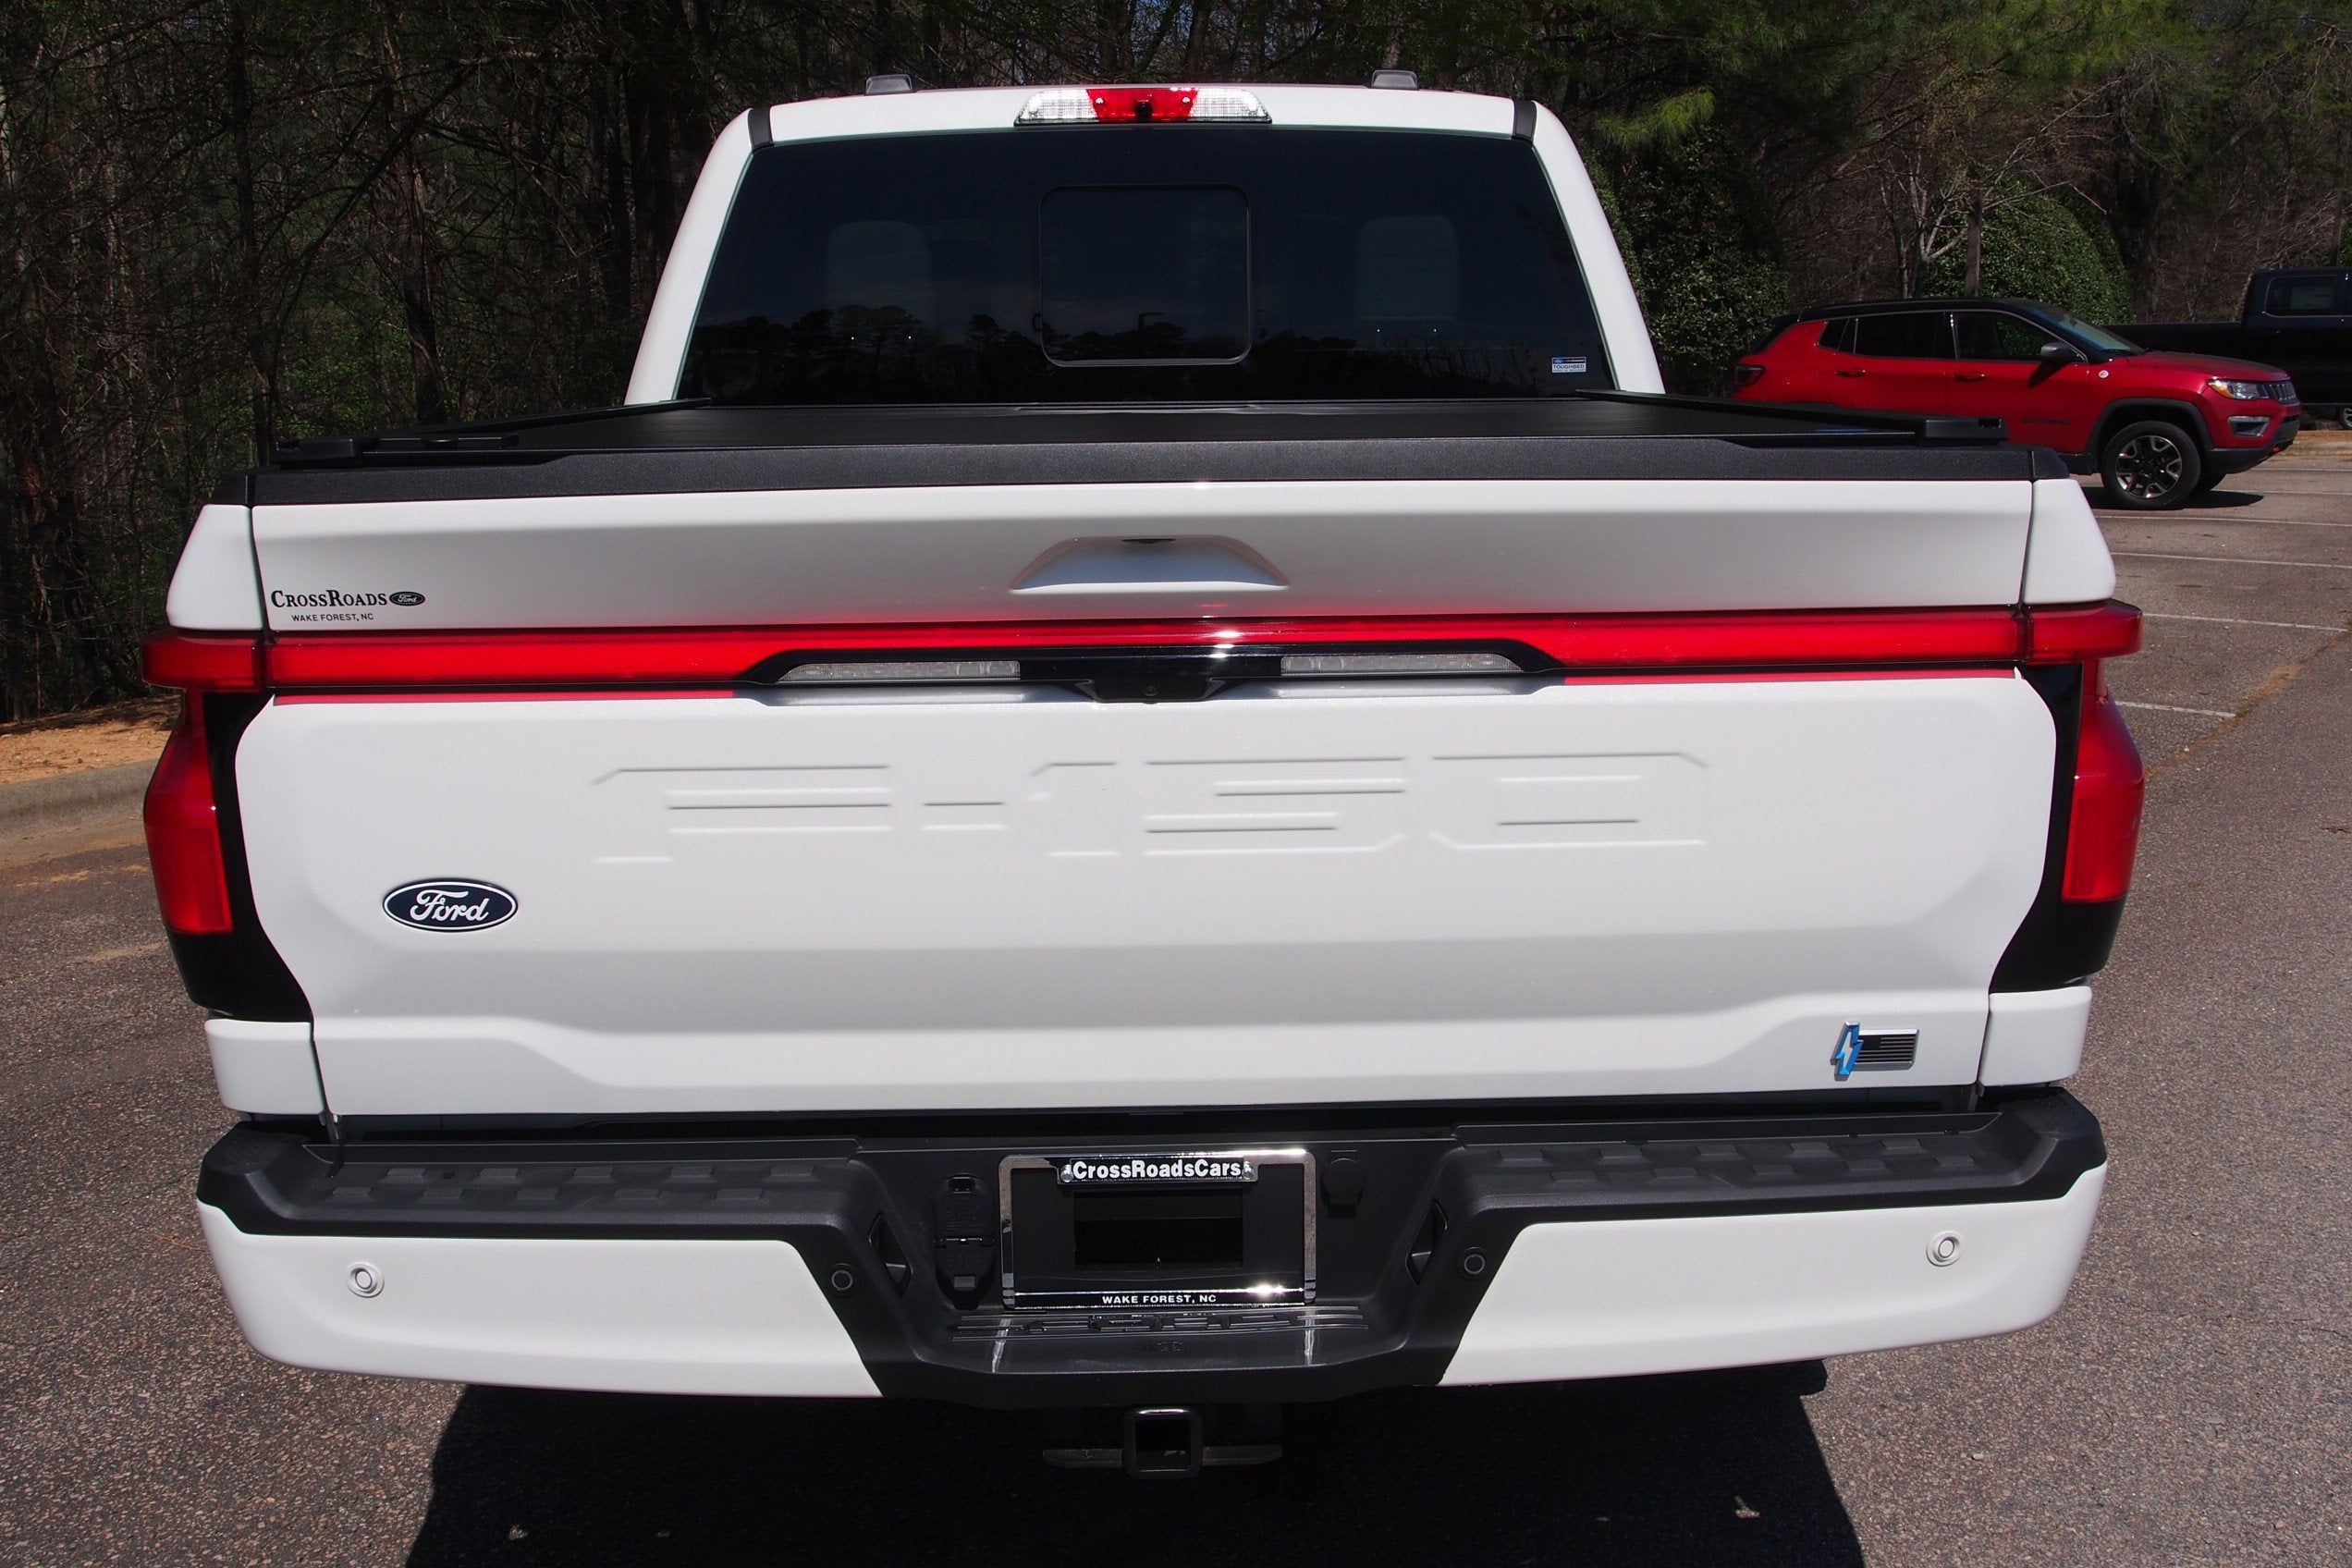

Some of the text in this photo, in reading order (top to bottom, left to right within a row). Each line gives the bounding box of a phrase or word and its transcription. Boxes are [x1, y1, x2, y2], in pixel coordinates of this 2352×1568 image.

[291, 614, 318, 622] WAKE
[321, 613, 360, 622] FOREST,
[410, 888, 490, 922] Ford
[1072, 1158, 1242, 1180] CrossRoadsCars
[1102, 1294, 1217, 1305] WAKE FOREST, NC
